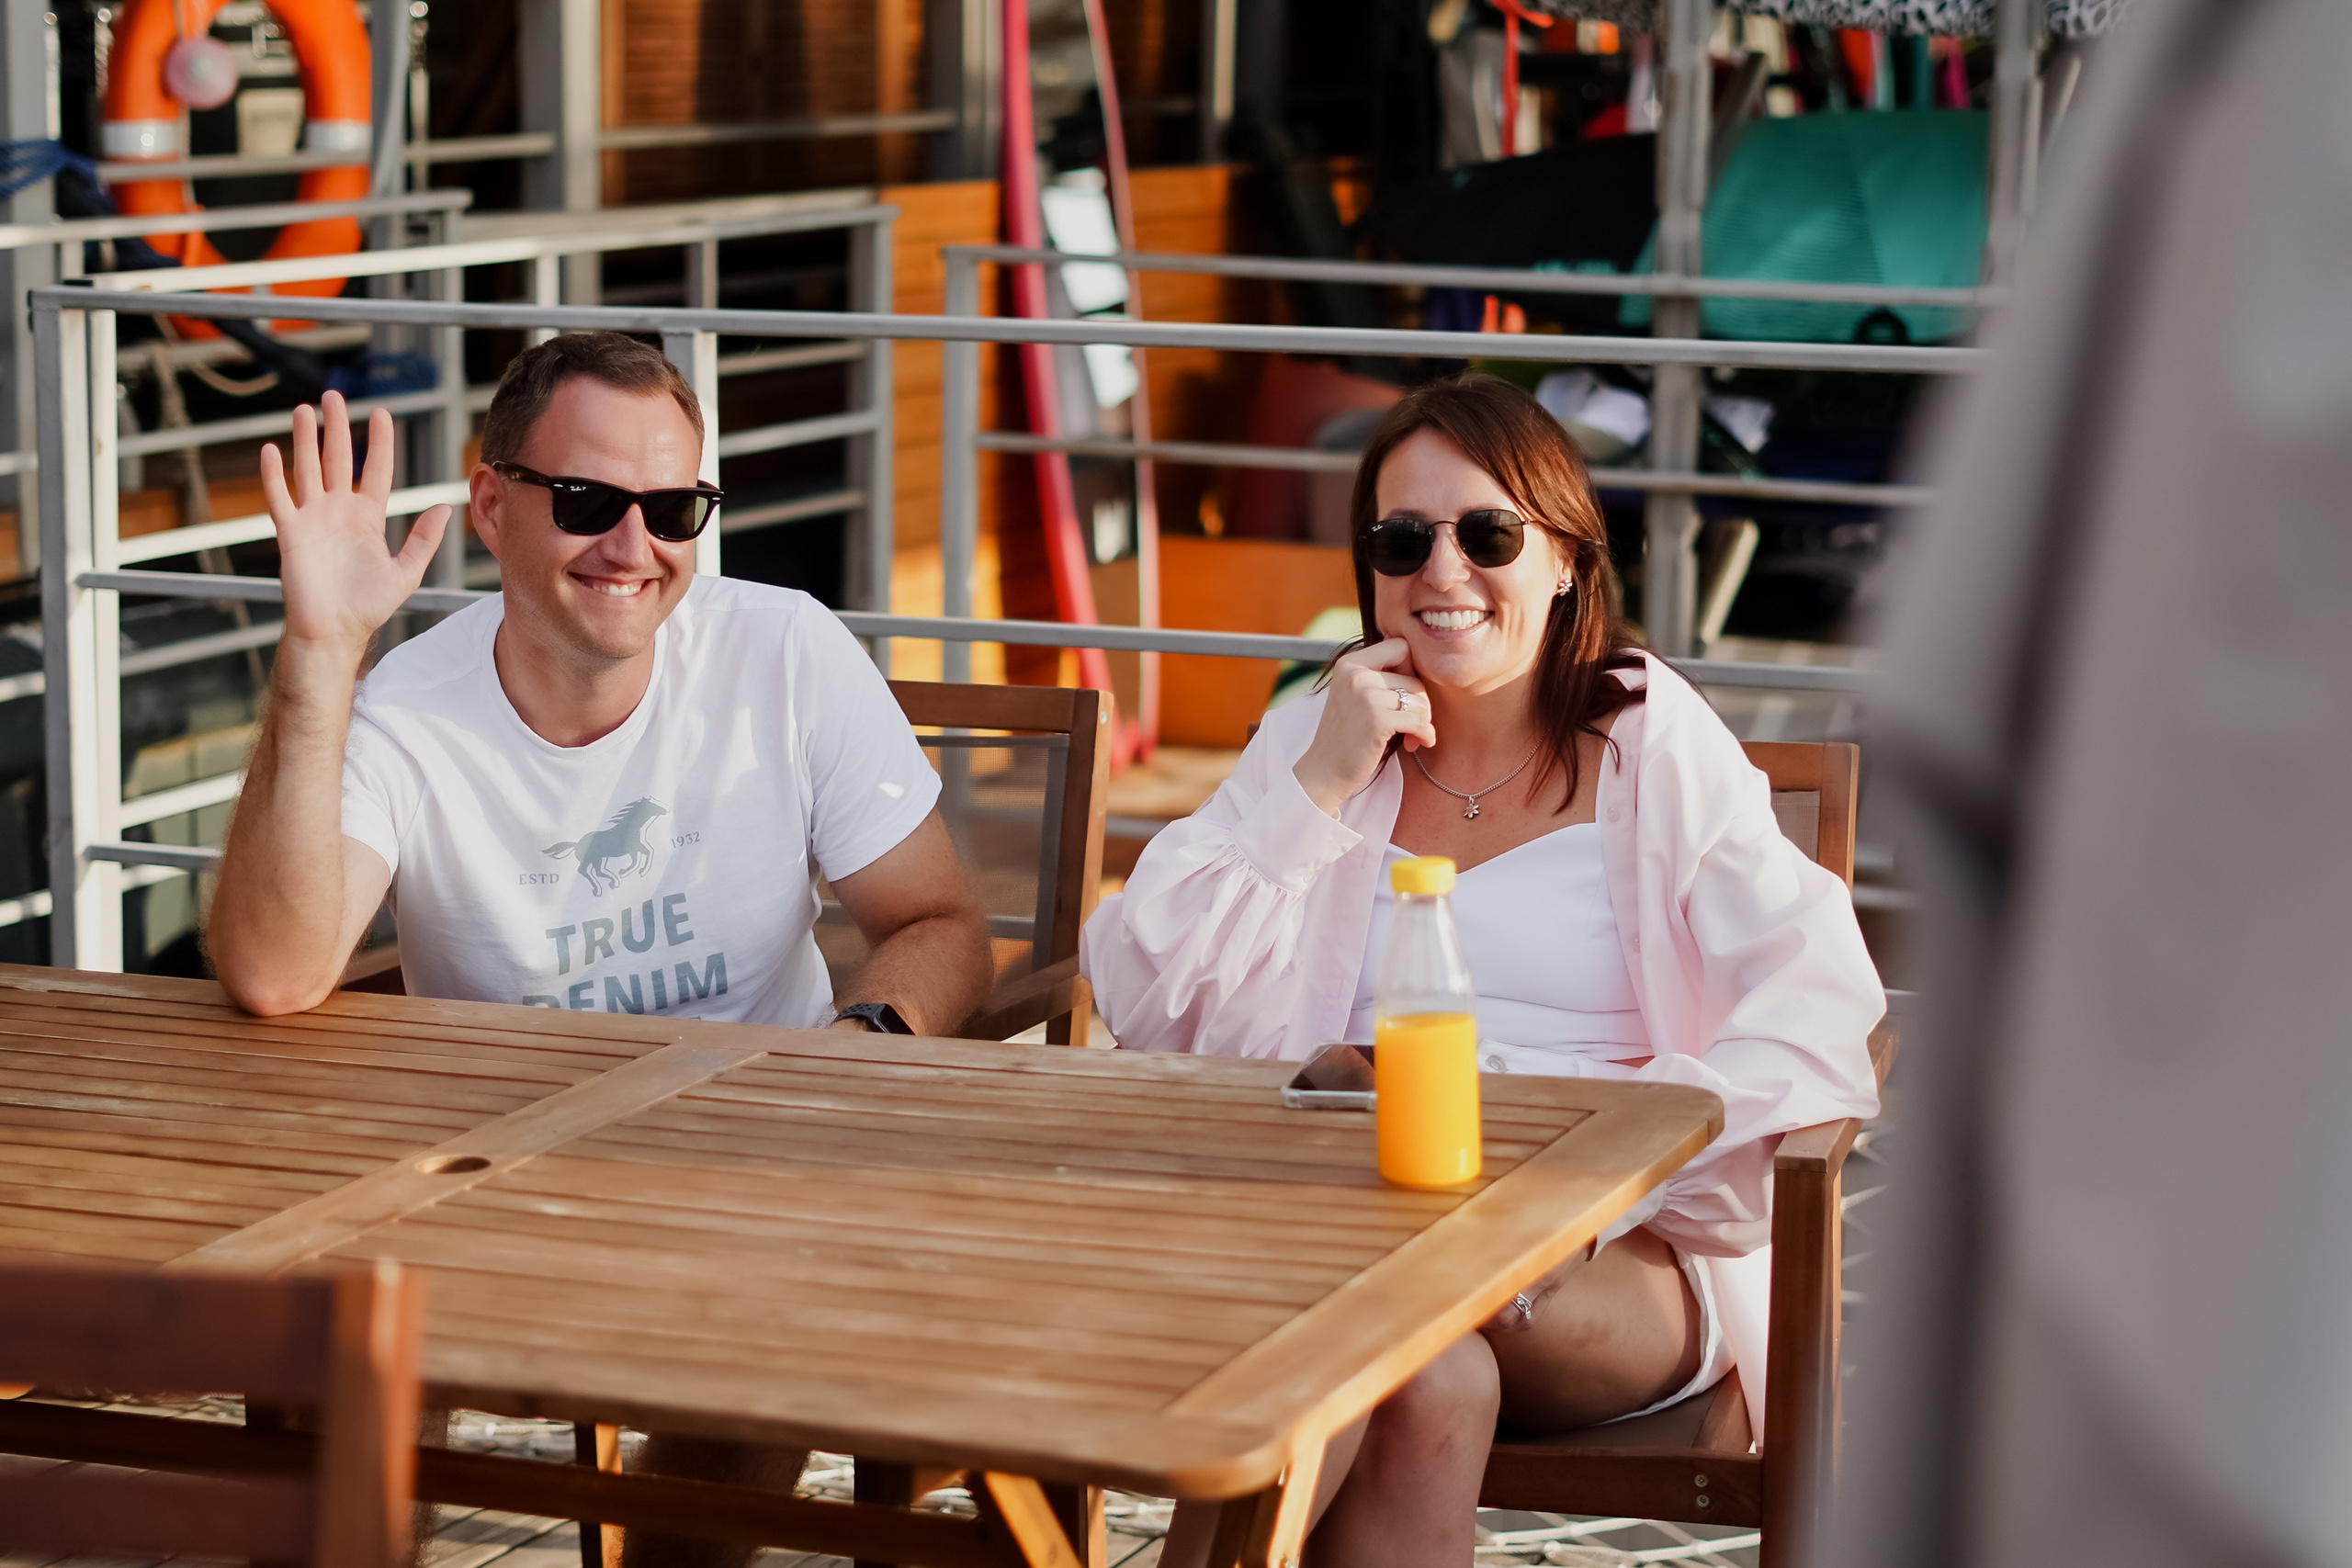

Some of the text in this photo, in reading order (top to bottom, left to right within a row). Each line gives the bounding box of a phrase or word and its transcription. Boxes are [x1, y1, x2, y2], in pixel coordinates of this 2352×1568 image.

[518, 831, 701, 886] ESTD 1932
[545, 892, 695, 976] TRUE
